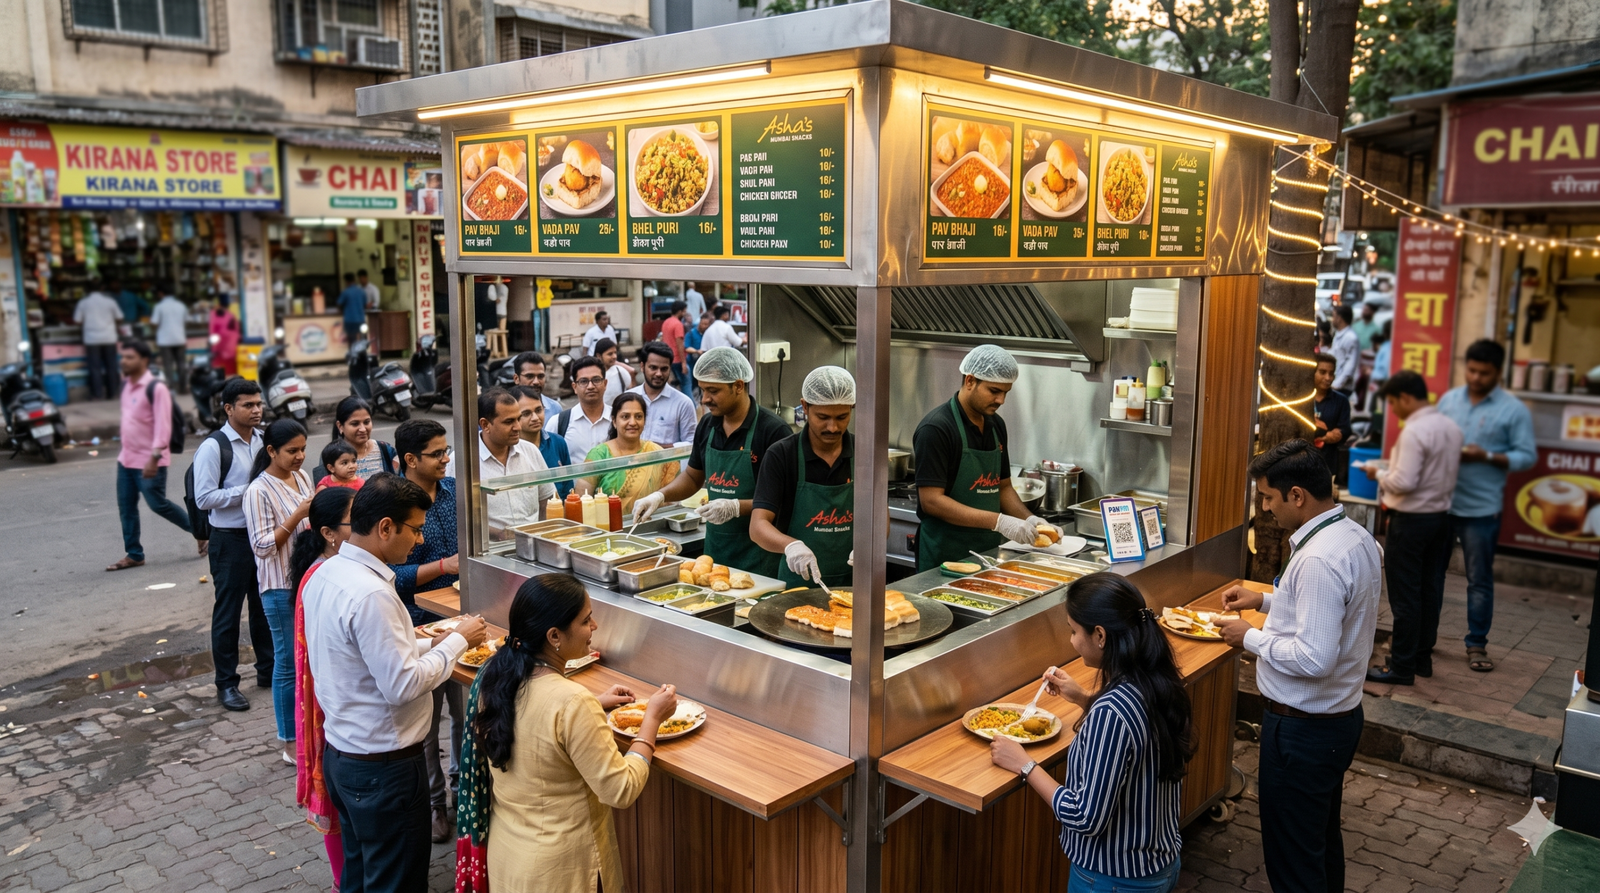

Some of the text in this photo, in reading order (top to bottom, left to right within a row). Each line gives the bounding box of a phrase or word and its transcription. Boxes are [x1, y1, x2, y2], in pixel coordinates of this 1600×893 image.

[757, 113, 813, 143] Asha's
[1474, 124, 1600, 163] CHAI
[65, 144, 158, 172] KIRANA
[166, 148, 238, 174] STORE
[86, 176, 222, 194] KIRANA STORE
[328, 164, 398, 192] CHAI
[740, 192, 768, 201] CHICKEN
[464, 224, 478, 236] PAV
[480, 224, 500, 236] BHAJI
[542, 224, 562, 234] VADA
[564, 224, 580, 234] PAV
[632, 222, 716, 234] BHEL PURI 16/-
[932, 222, 949, 236] PAV
[950, 222, 976, 236] BHAJI
[1022, 225, 1042, 237] VADA
[1044, 226, 1058, 238] PAV
[1097, 228, 1113, 239] BHEL
[1114, 228, 1130, 240] PURI
[1547, 452, 1590, 472] CHAI
[806, 508, 854, 528] Asha's
